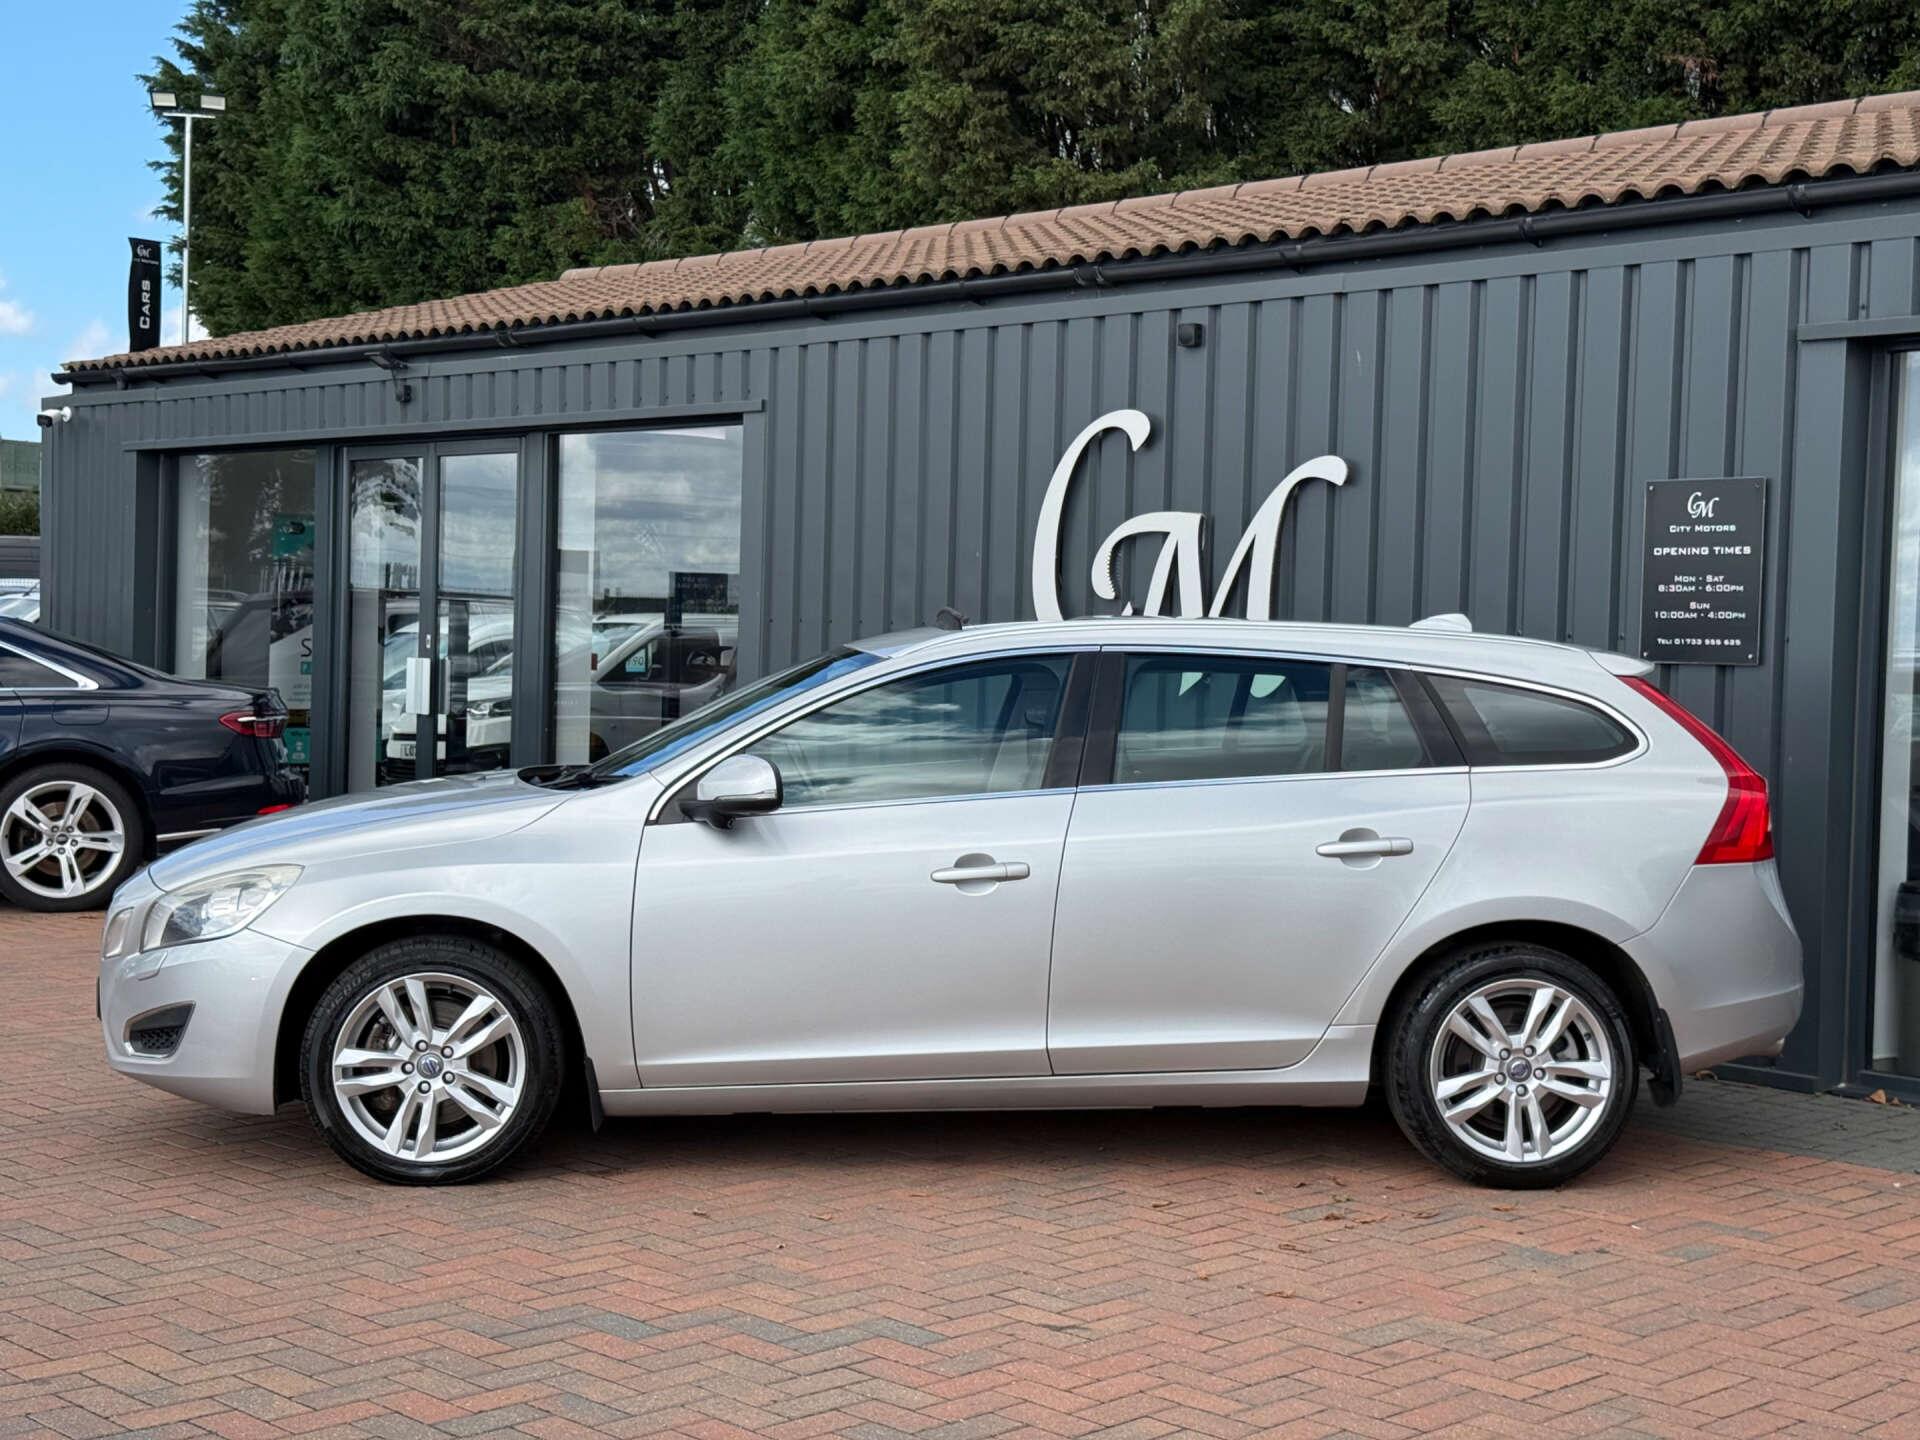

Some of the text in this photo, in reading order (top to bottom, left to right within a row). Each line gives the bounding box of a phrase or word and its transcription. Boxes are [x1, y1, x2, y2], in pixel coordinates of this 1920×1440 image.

[140, 280, 151, 329] CARS
[1669, 524, 1737, 533] CITY MOTORS
[1653, 545, 1752, 556] OPENING TIMES
[1689, 601, 1711, 610] SUN
